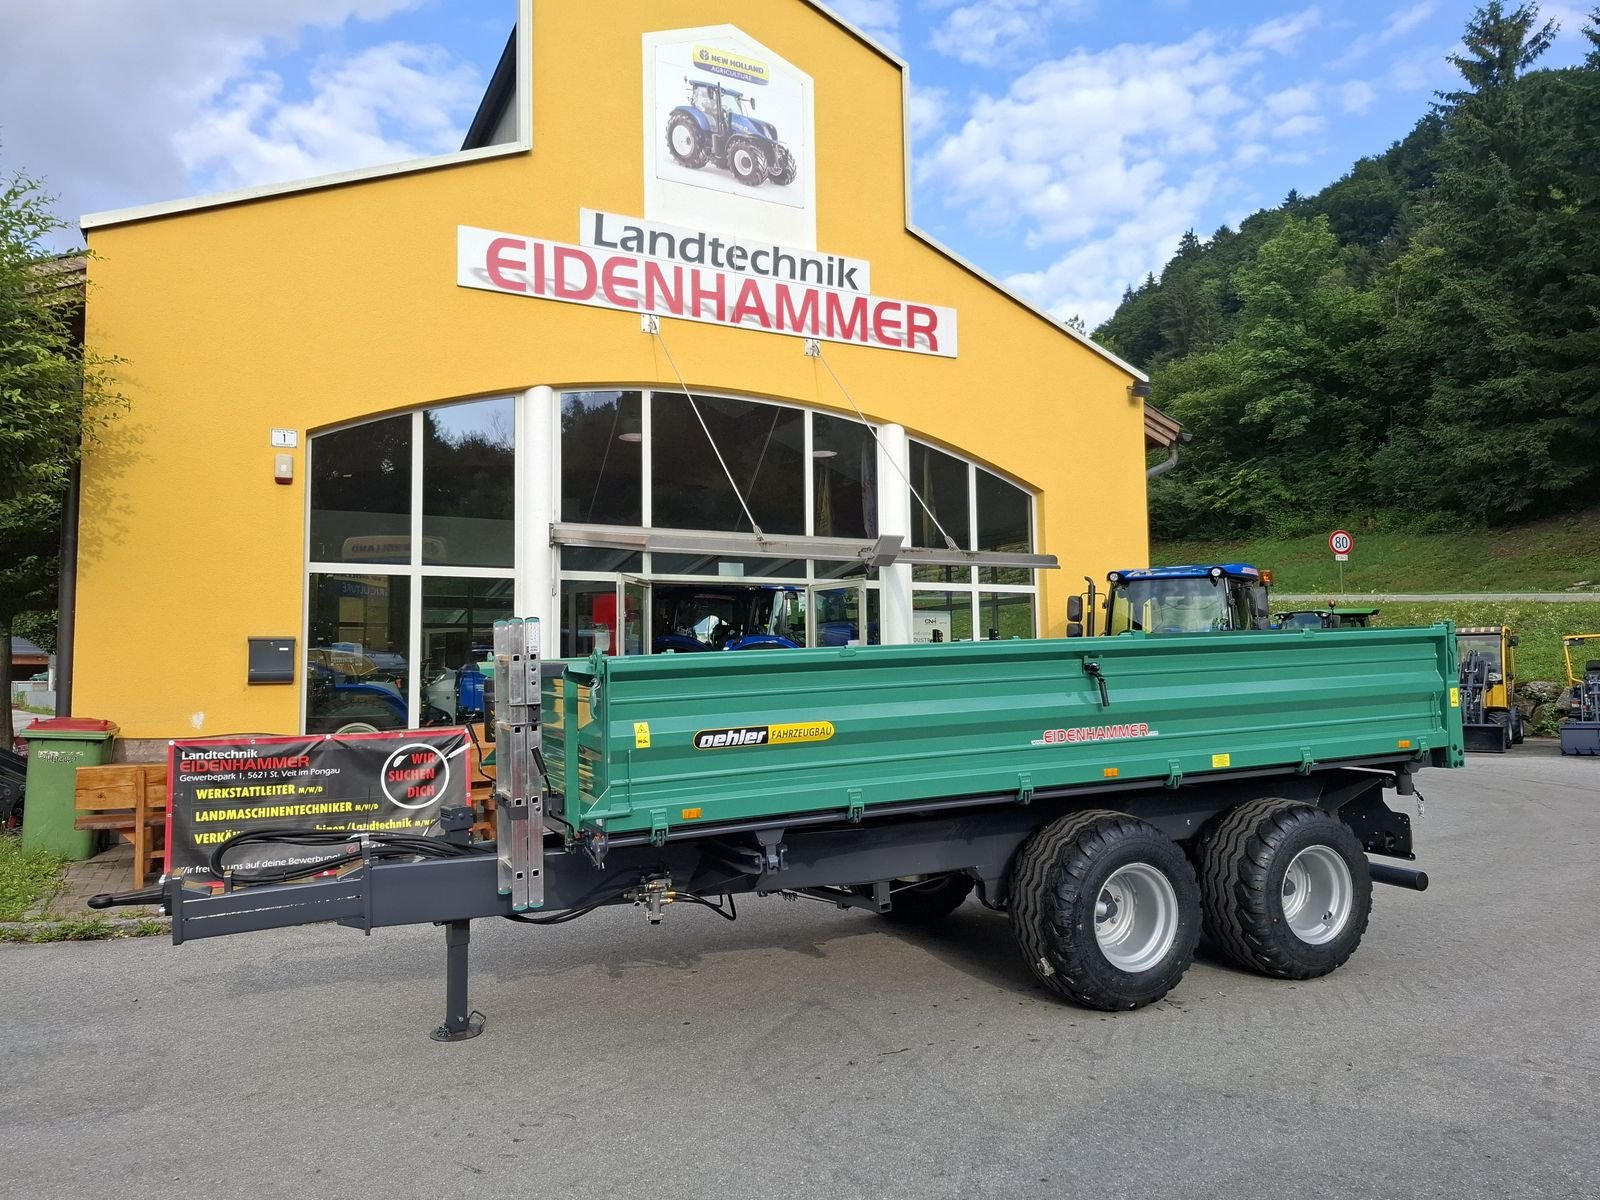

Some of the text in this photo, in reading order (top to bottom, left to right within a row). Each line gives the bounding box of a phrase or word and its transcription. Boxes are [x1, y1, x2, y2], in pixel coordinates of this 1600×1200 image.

[711, 55, 764, 74] NEW HOLLAND
[711, 65, 753, 81] AGRICULTURE
[594, 212, 859, 290] Landtechnik
[485, 237, 939, 351] EIDENHAMMER
[283, 433, 286, 443] 1
[1335, 536, 1348, 549] 80
[699, 726, 832, 748] oehler FAHRZEUGBAU
[1044, 724, 1148, 743] EIDENHAMMER
[181, 749, 258, 761] Landtechnik
[411, 752, 436, 765] WIR
[179, 755, 311, 773] EIDENHAMMER
[179, 767, 341, 783] Gewerbepark 1, 5621 St. Veit im Pongau
[388, 767, 436, 783] SUCHEN
[196, 784, 323, 800] WERKSTATTLEITER M/W/D
[407, 784, 436, 799] DICH
[195, 801, 353, 823] LANDMASCHINENTECHNIKER
[245, 860, 260, 869] auf
[261, 857, 286, 867] deine
